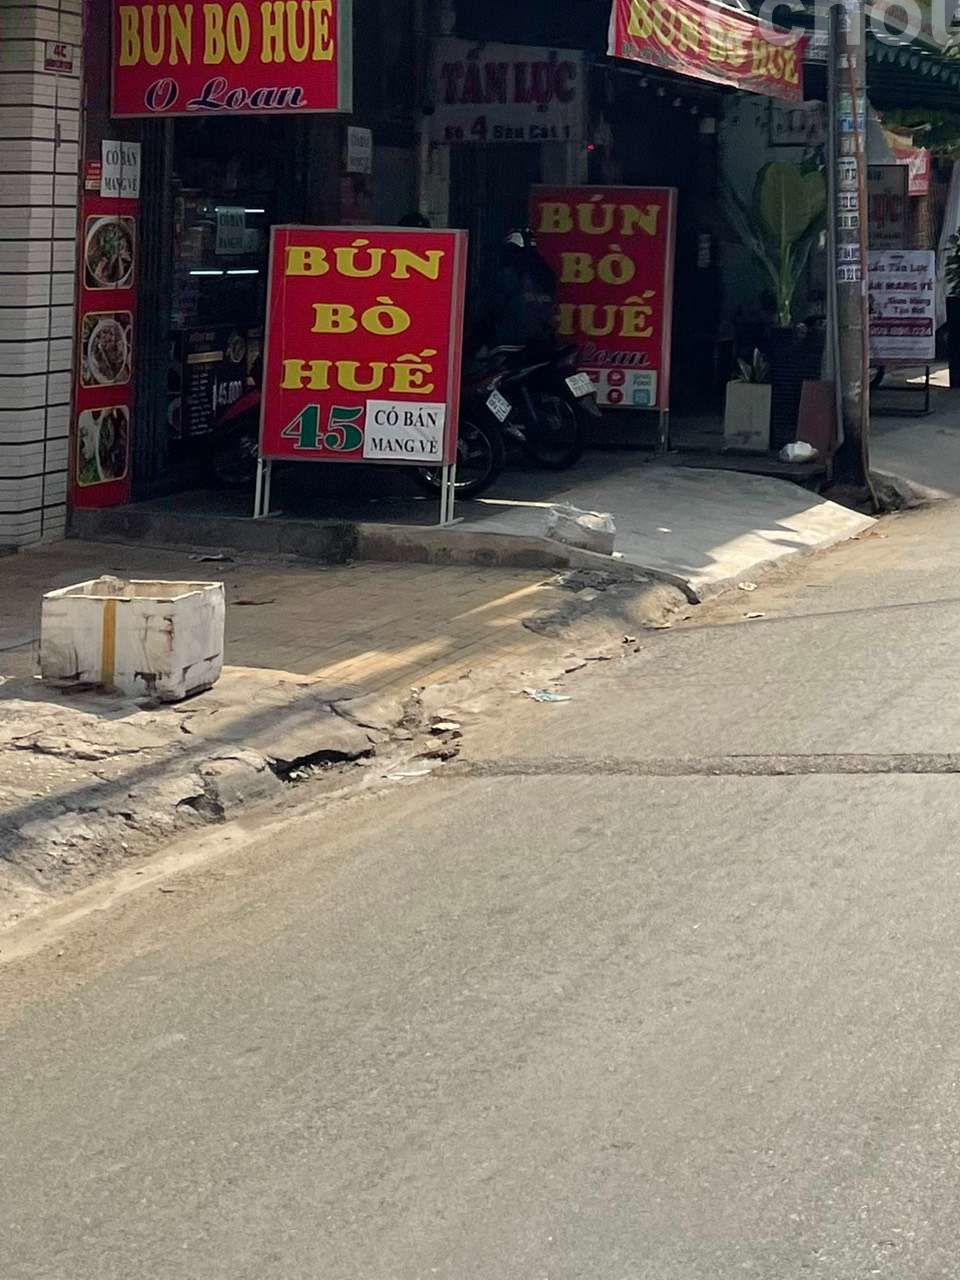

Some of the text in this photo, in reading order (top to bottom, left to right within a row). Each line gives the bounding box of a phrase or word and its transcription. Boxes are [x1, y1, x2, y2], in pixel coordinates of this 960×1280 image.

[186, 76, 308, 110] Loan
[538, 194, 661, 236] BÚN
[285, 239, 445, 280] BÚN
[560, 244, 635, 285] BÒ
[311, 296, 411, 336] BÒ
[280, 349, 438, 394] HUẾ
[281, 404, 364, 452] 45
[374, 406, 438, 428] CÓ BÁN
[370, 436, 438, 454] MANG VỀ
